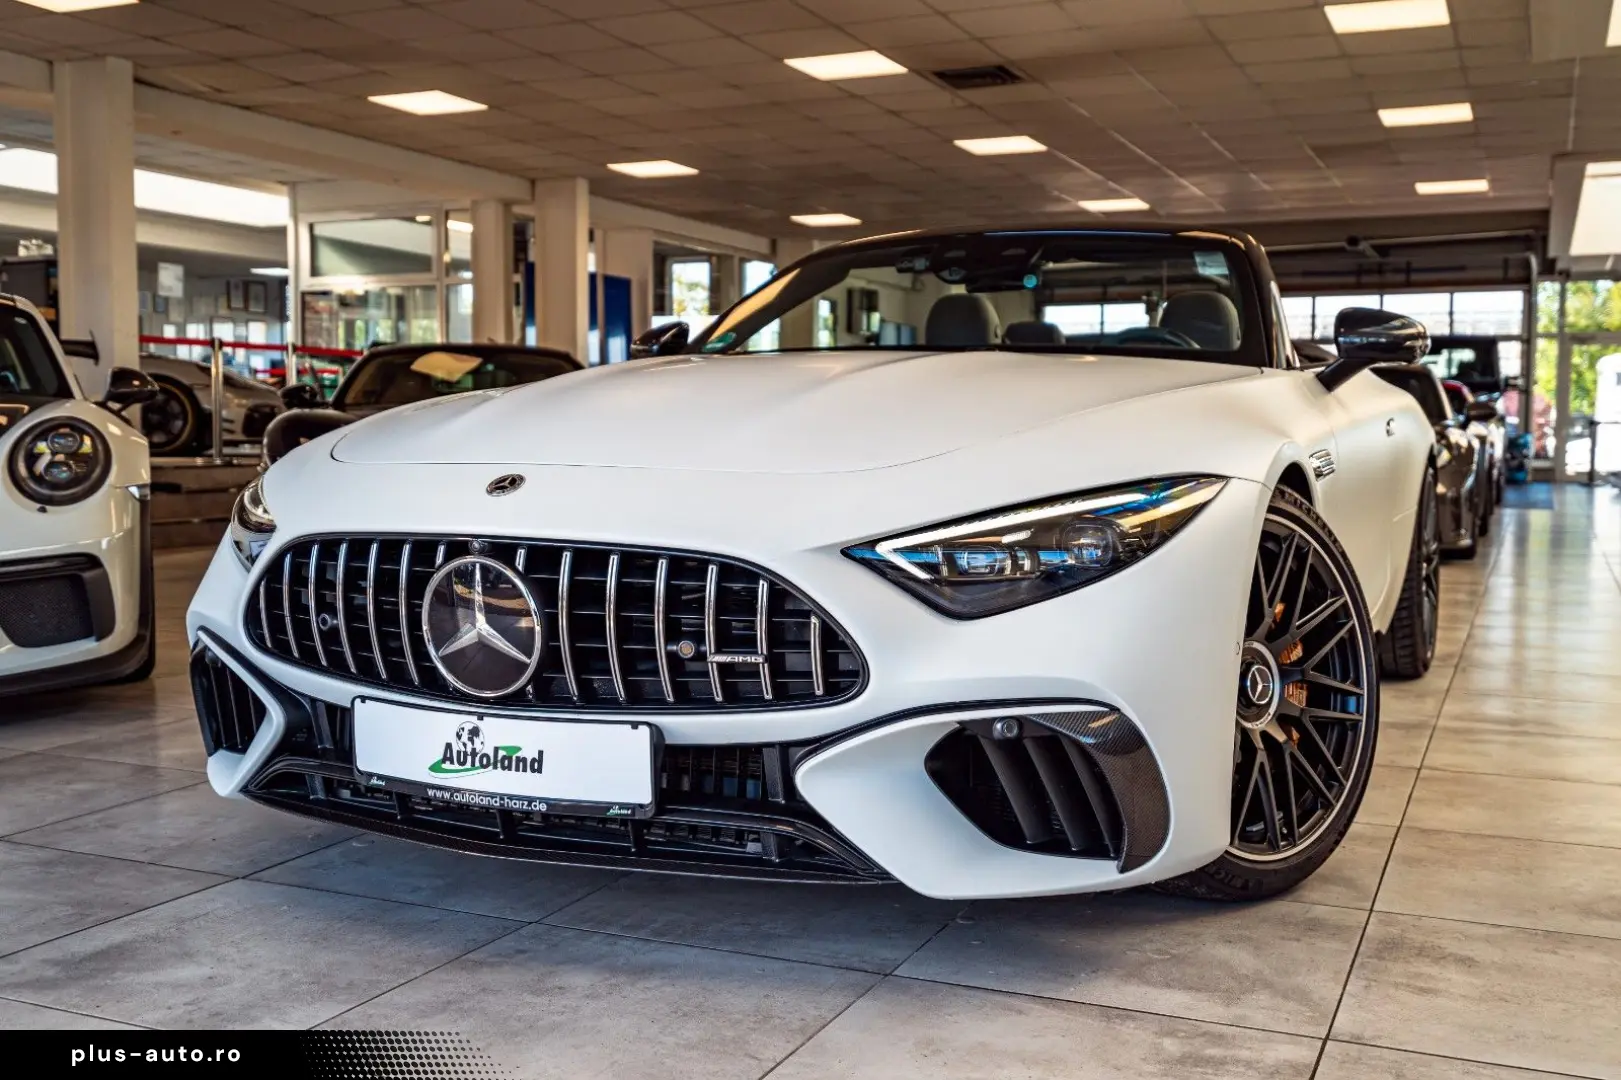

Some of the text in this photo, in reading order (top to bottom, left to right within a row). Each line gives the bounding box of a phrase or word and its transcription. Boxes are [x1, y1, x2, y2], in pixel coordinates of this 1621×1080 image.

[724, 655, 763, 663] AMG
[441, 742, 544, 774] Autoland
[426, 787, 547, 812] www.autoland-harz.de
